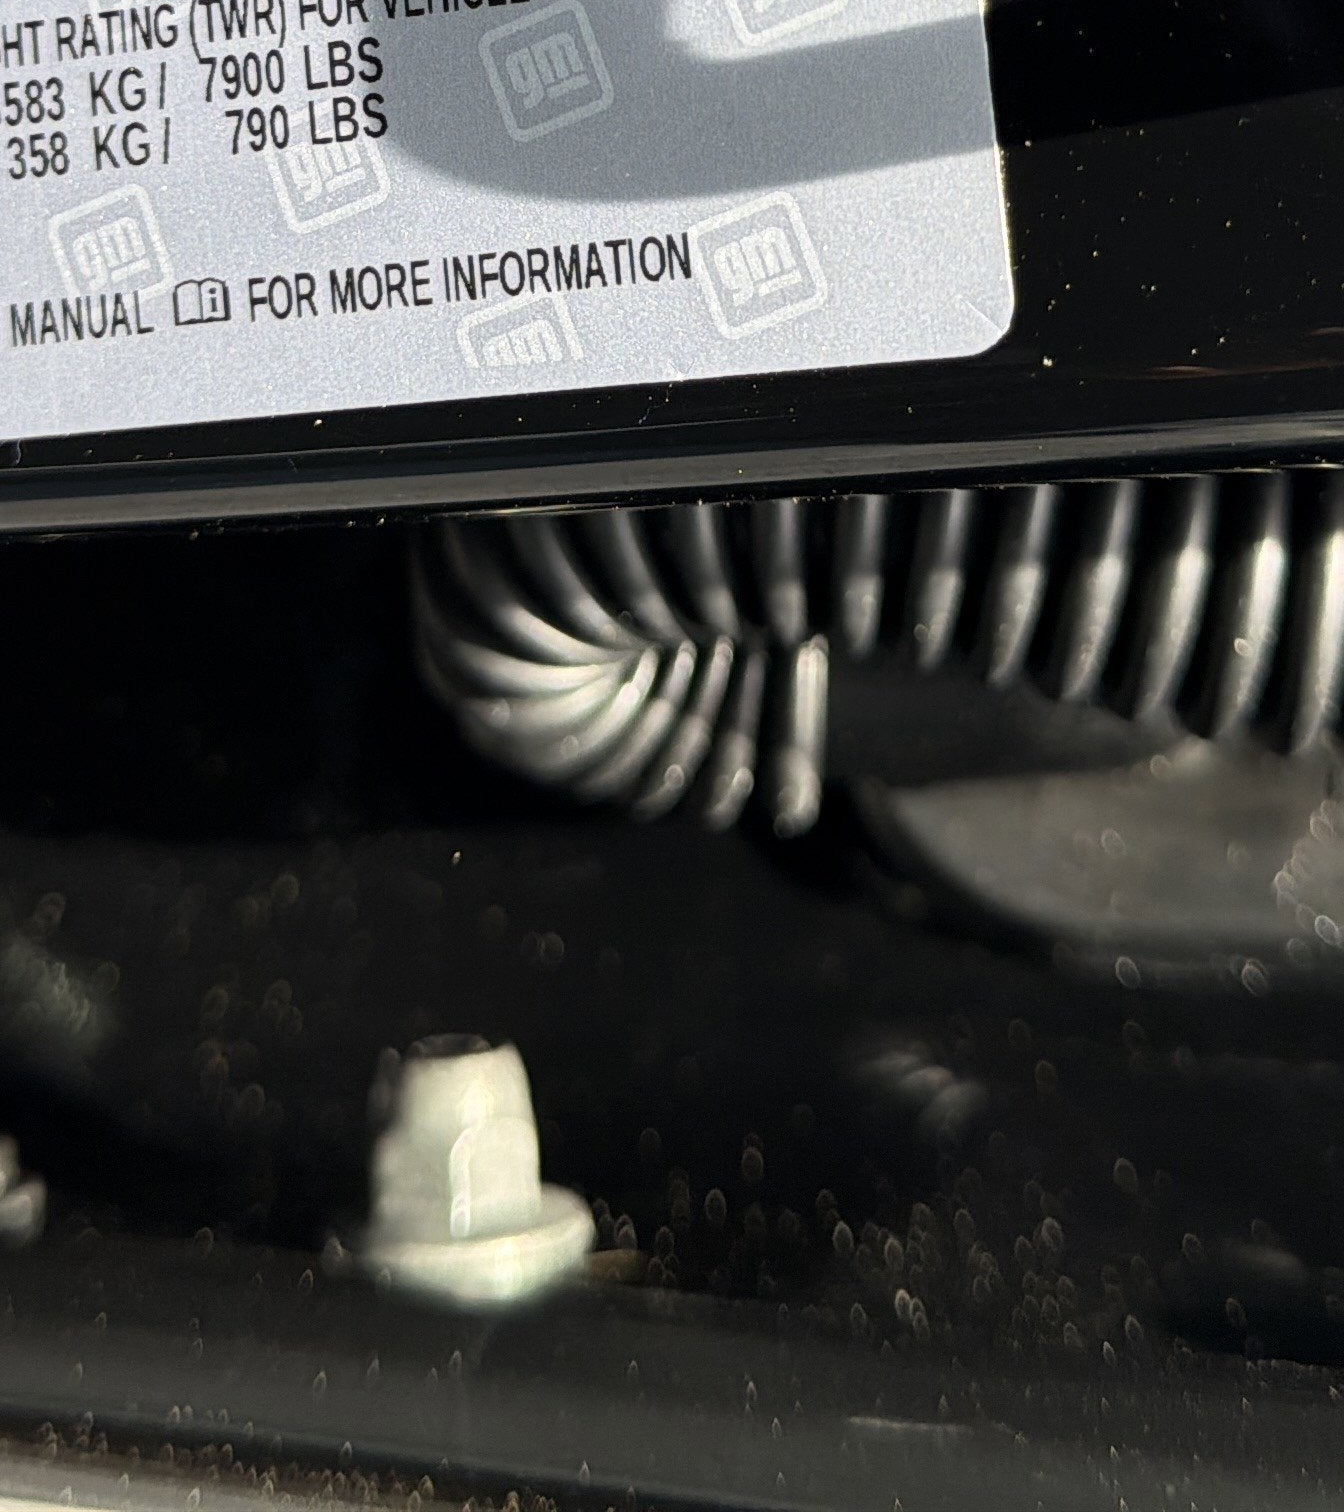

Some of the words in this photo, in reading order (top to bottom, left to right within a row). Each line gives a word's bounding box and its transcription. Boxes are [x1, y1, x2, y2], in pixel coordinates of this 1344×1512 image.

[56, 4, 178, 61] RATING
[199, 50, 284, 102] 7900
[304, 37, 383, 90] LBS
[7, 131, 70, 179] 358
[225, 105, 289, 155] 790
[309, 93, 388, 145] LBS
[11, 291, 154, 346] MANUAL
[249, 273, 318, 322] FOR
[330, 260, 432, 313] MORE
[443, 233, 691, 302] INFORMATION
